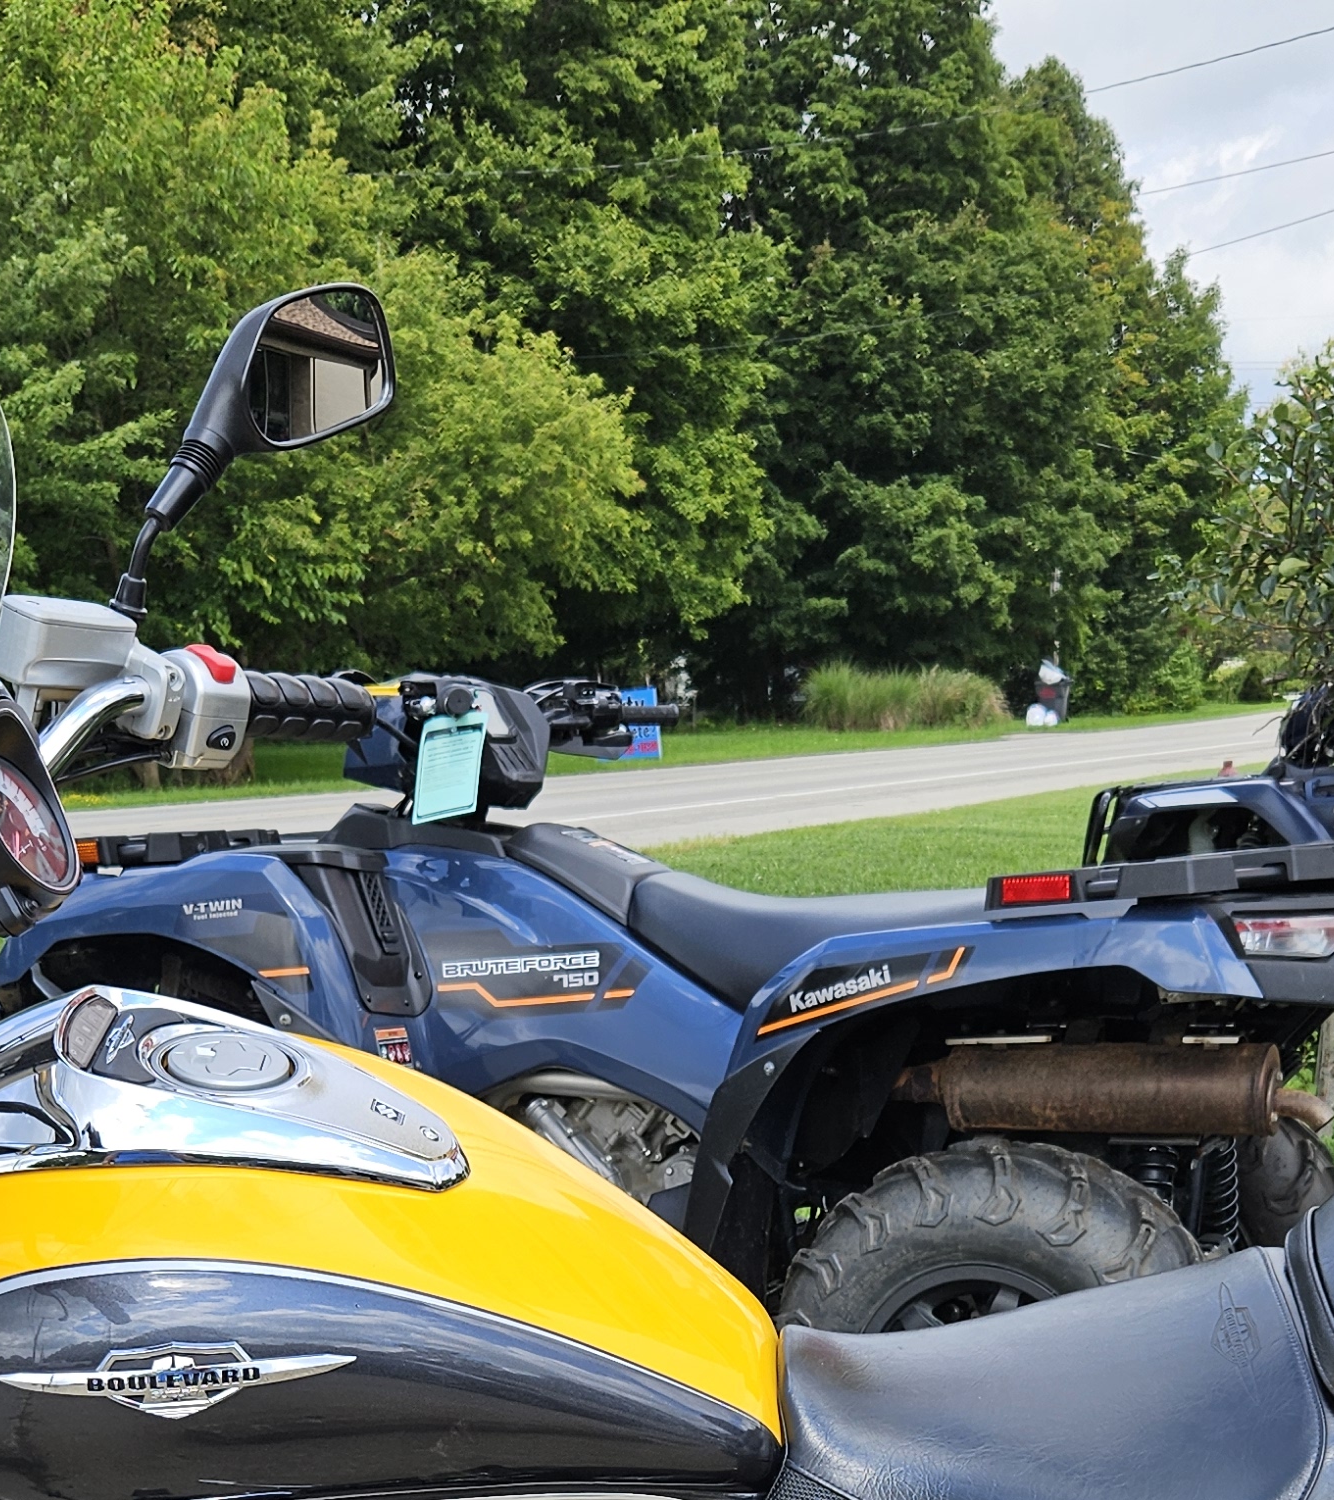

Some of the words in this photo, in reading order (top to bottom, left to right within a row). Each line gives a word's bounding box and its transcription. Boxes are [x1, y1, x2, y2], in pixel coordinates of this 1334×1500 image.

[182, 898, 243, 915] V-TWIN
[442, 957, 520, 978] BRUTE
[522, 951, 600, 973] FORCE
[552, 971, 599, 988] 750
[788, 964, 892, 1014] Kawasaki
[86, 1366, 261, 1393] BOULEVARD
